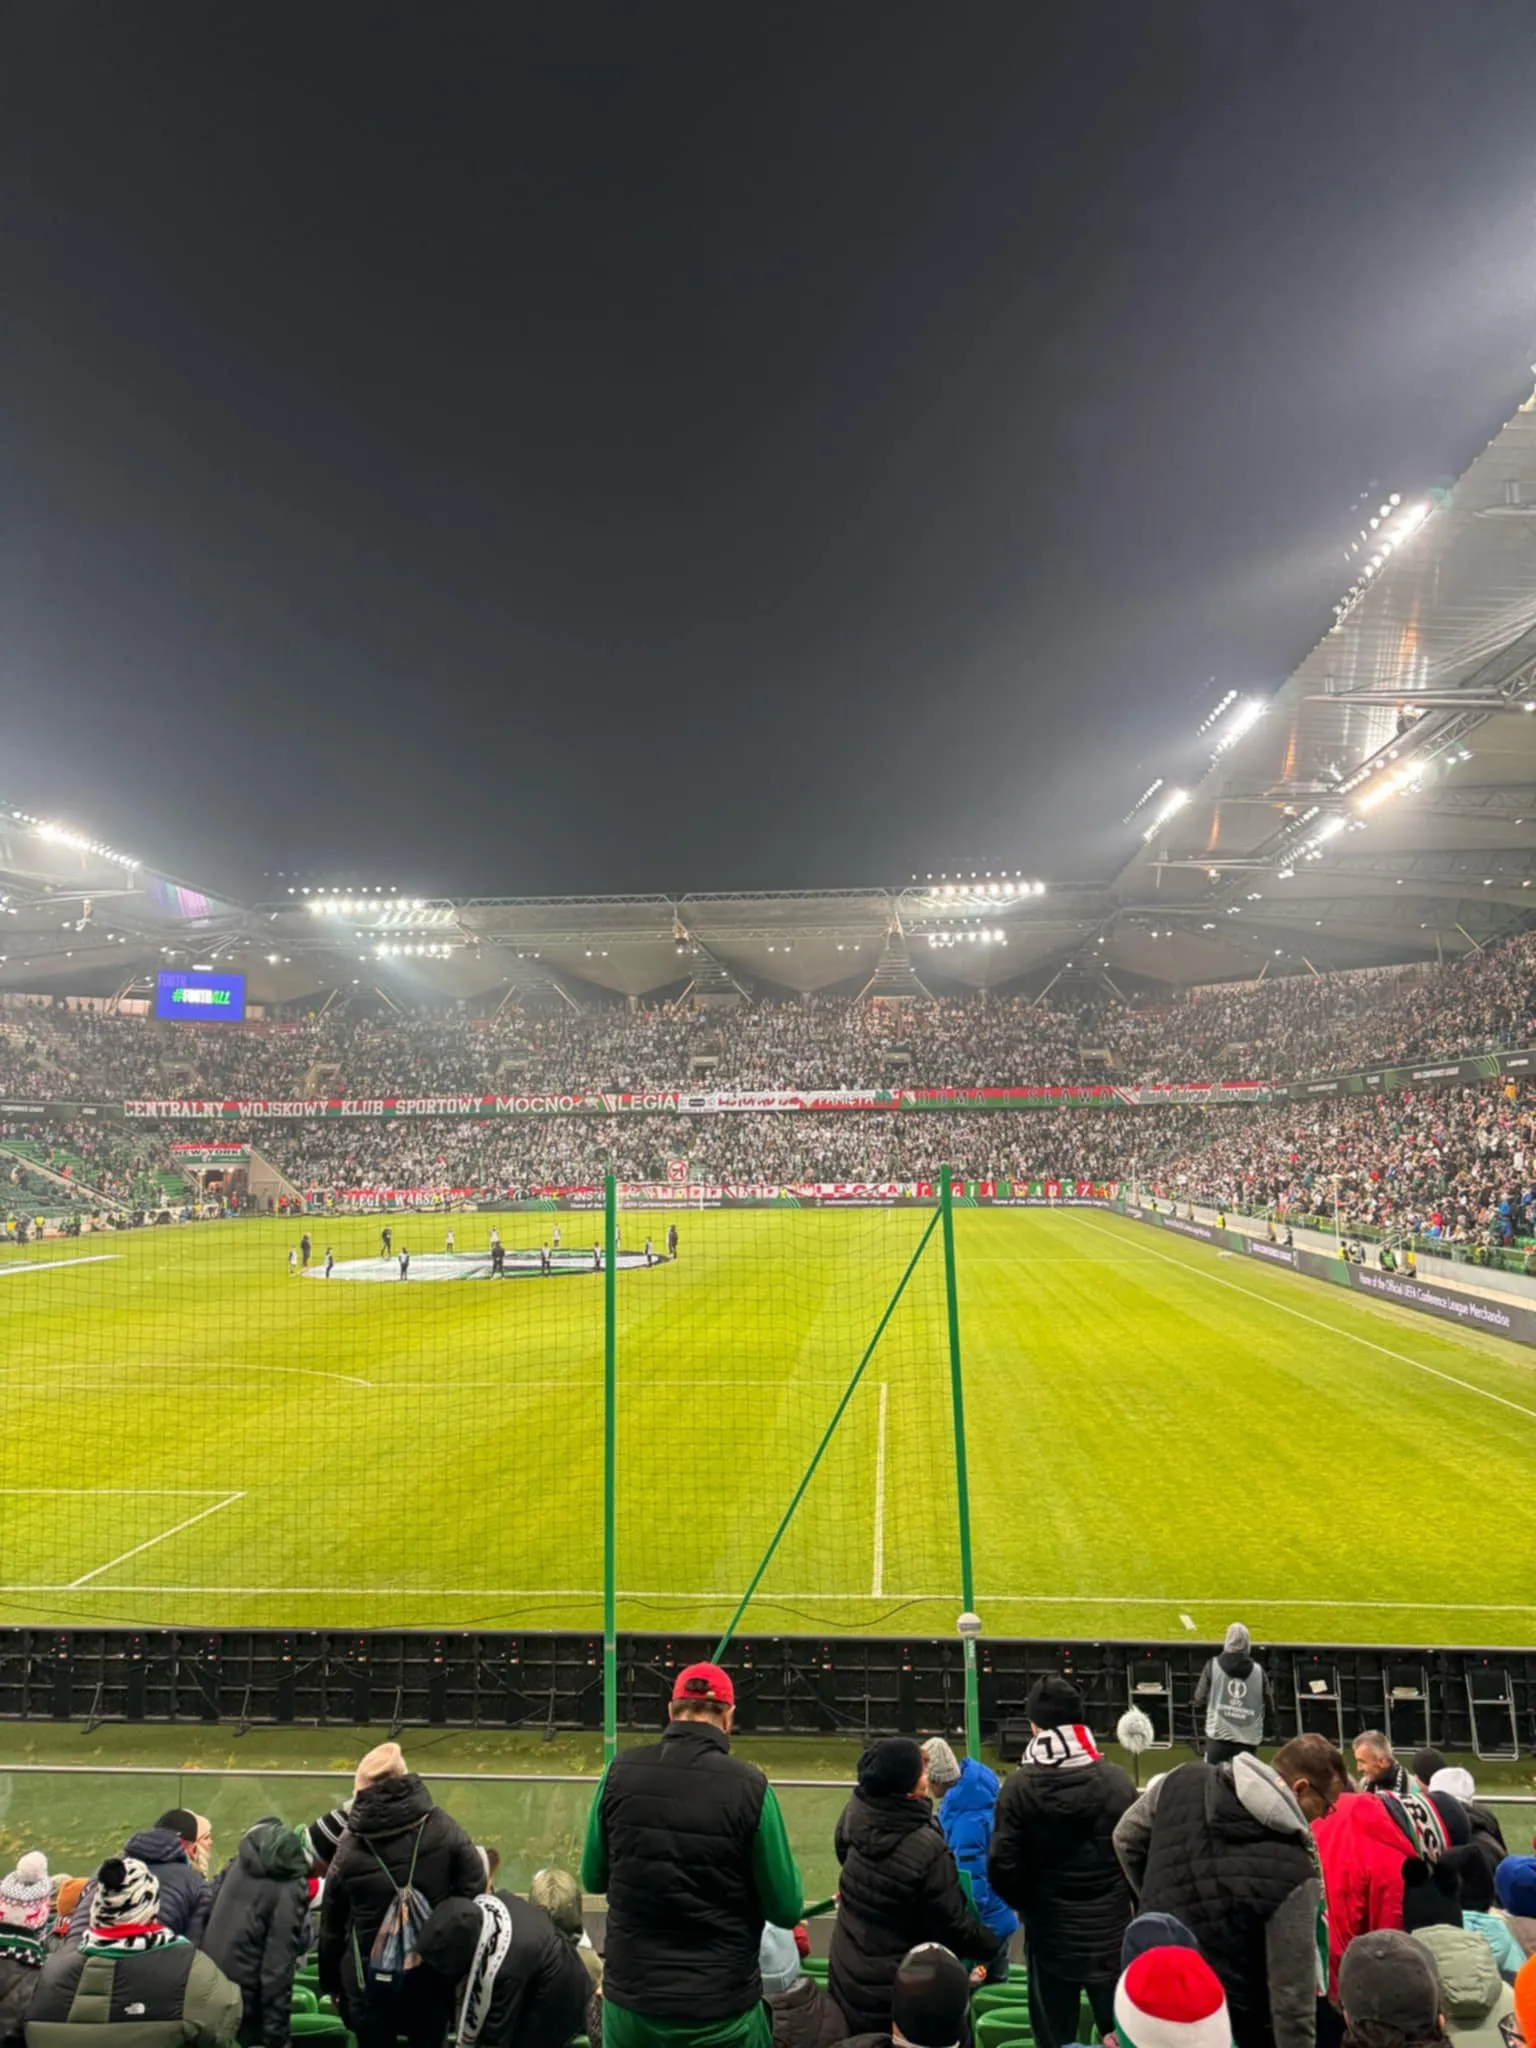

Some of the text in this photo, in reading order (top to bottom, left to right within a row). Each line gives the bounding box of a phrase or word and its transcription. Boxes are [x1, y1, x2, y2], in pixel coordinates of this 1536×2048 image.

[124, 1098, 483, 1118] CENTRALNY WOJSKOWY KLUB SPORTOWY
[496, 1095, 574, 1113] MOCNO
[618, 1093, 678, 1111] LEGIA
[1404, 1284, 1416, 1298] UEFA
[1417, 1288, 1448, 1309] Conference
[1447, 1296, 1468, 1317] League
[1469, 1301, 1512, 1328] Merchandise
